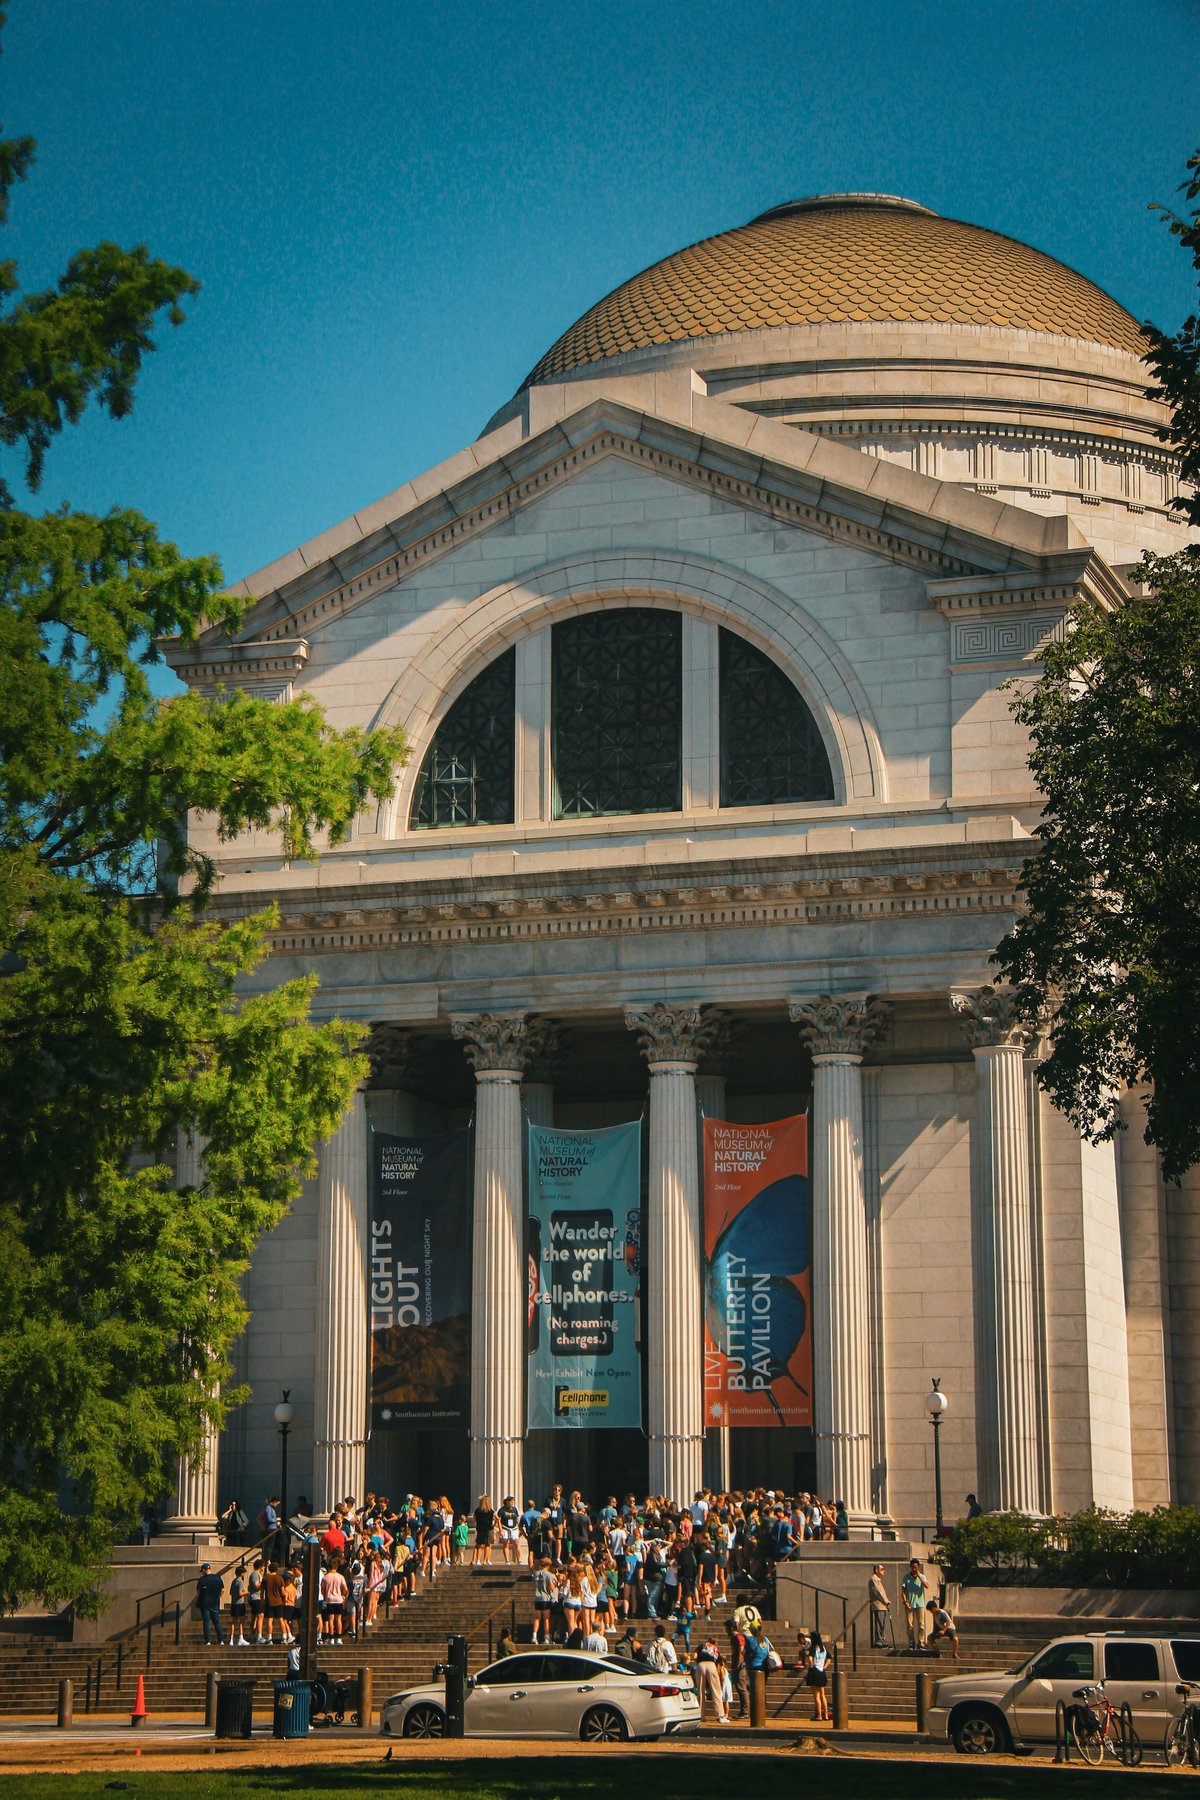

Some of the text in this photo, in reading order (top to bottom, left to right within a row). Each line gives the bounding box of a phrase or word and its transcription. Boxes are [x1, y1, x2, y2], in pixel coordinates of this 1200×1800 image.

[714, 1128, 772, 1139] NATIONAL
[539, 1135, 594, 1146] NATIONAL
[714, 1139, 773, 1152] MUSEUM of
[382, 1147, 423, 1155] NATIONAL
[539, 1146, 595, 1158] MUSEUM of
[714, 1151, 767, 1161] NATURAL
[382, 1155, 416, 1163] MUSEUM
[539, 1157, 589, 1166] NATURAL
[382, 1163, 419, 1171] NATURAL
[539, 1167, 583, 1177] HISTORY
[714, 1162, 762, 1172] HISTORY
[727, 1183, 742, 1191] Floor
[548, 1221, 618, 1240] Wander
[543, 1240, 625, 1262] the world
[424, 1259, 432, 1276] OUR
[571, 1262, 592, 1282] of
[371, 1219, 394, 1329] LIGHTS
[397, 1261, 420, 1328] OUT
[533, 1284, 634, 1311] cellphones.
[547, 1316, 619, 1333] (No roaming
[726, 1251, 747, 1391] BUTTERFLY
[751, 1273, 772, 1391] PAVILION
[556, 1332, 608, 1349] charges.)
[704, 1341, 722, 1390] LIVE
[555, 1368, 583, 1378] Exhibit
[586, 1368, 604, 1378] Now
[607, 1368, 631, 1380] Open
[562, 1393, 607, 1405] cellphone
[394, 1410, 431, 1418] Smithsonian
[729, 1406, 809, 1415] Smithsonian Institution
